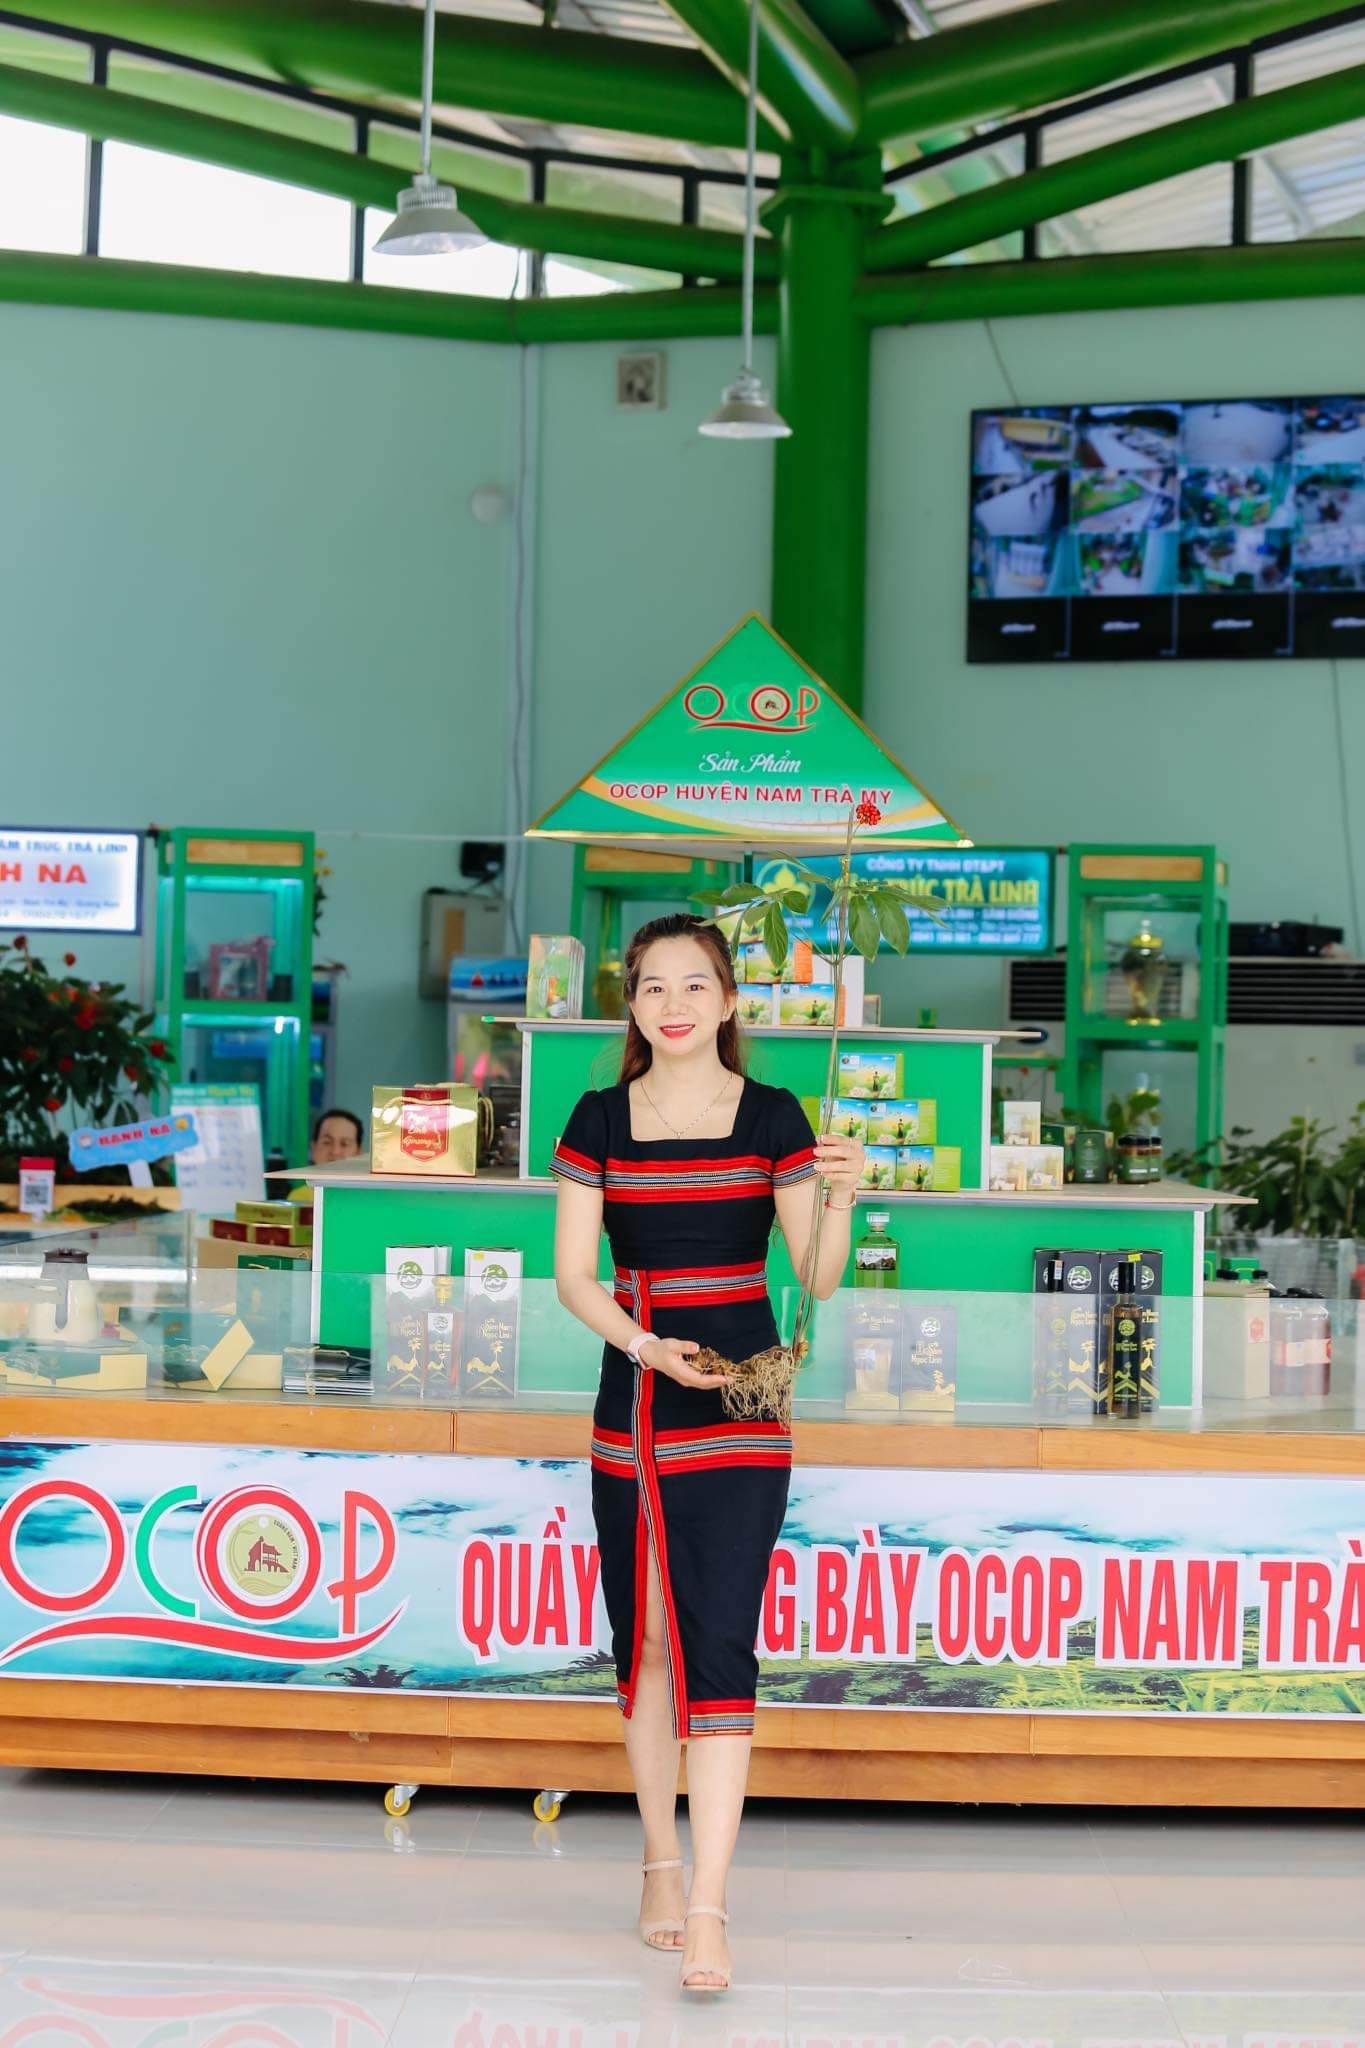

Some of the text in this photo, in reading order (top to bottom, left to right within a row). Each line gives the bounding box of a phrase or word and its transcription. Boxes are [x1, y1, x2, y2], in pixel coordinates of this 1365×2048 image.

[684, 683, 820, 726] OCOP
[699, 749, 801, 773] Sản Phẩm
[610, 781, 892, 804] OCOP HUYỆN NAM TRÀ MY
[38, 863, 87, 884] NA
[944, 874, 984, 904] TRÀ
[988, 878, 1040, 905] LINH
[0, 1481, 395, 1634] OCOP
[462, 1507, 602, 1657] QUẦY
[815, 1530, 920, 1654] BÀY
[939, 1555, 1082, 1658] OCOP
[1102, 1560, 1238, 1660] NAM
